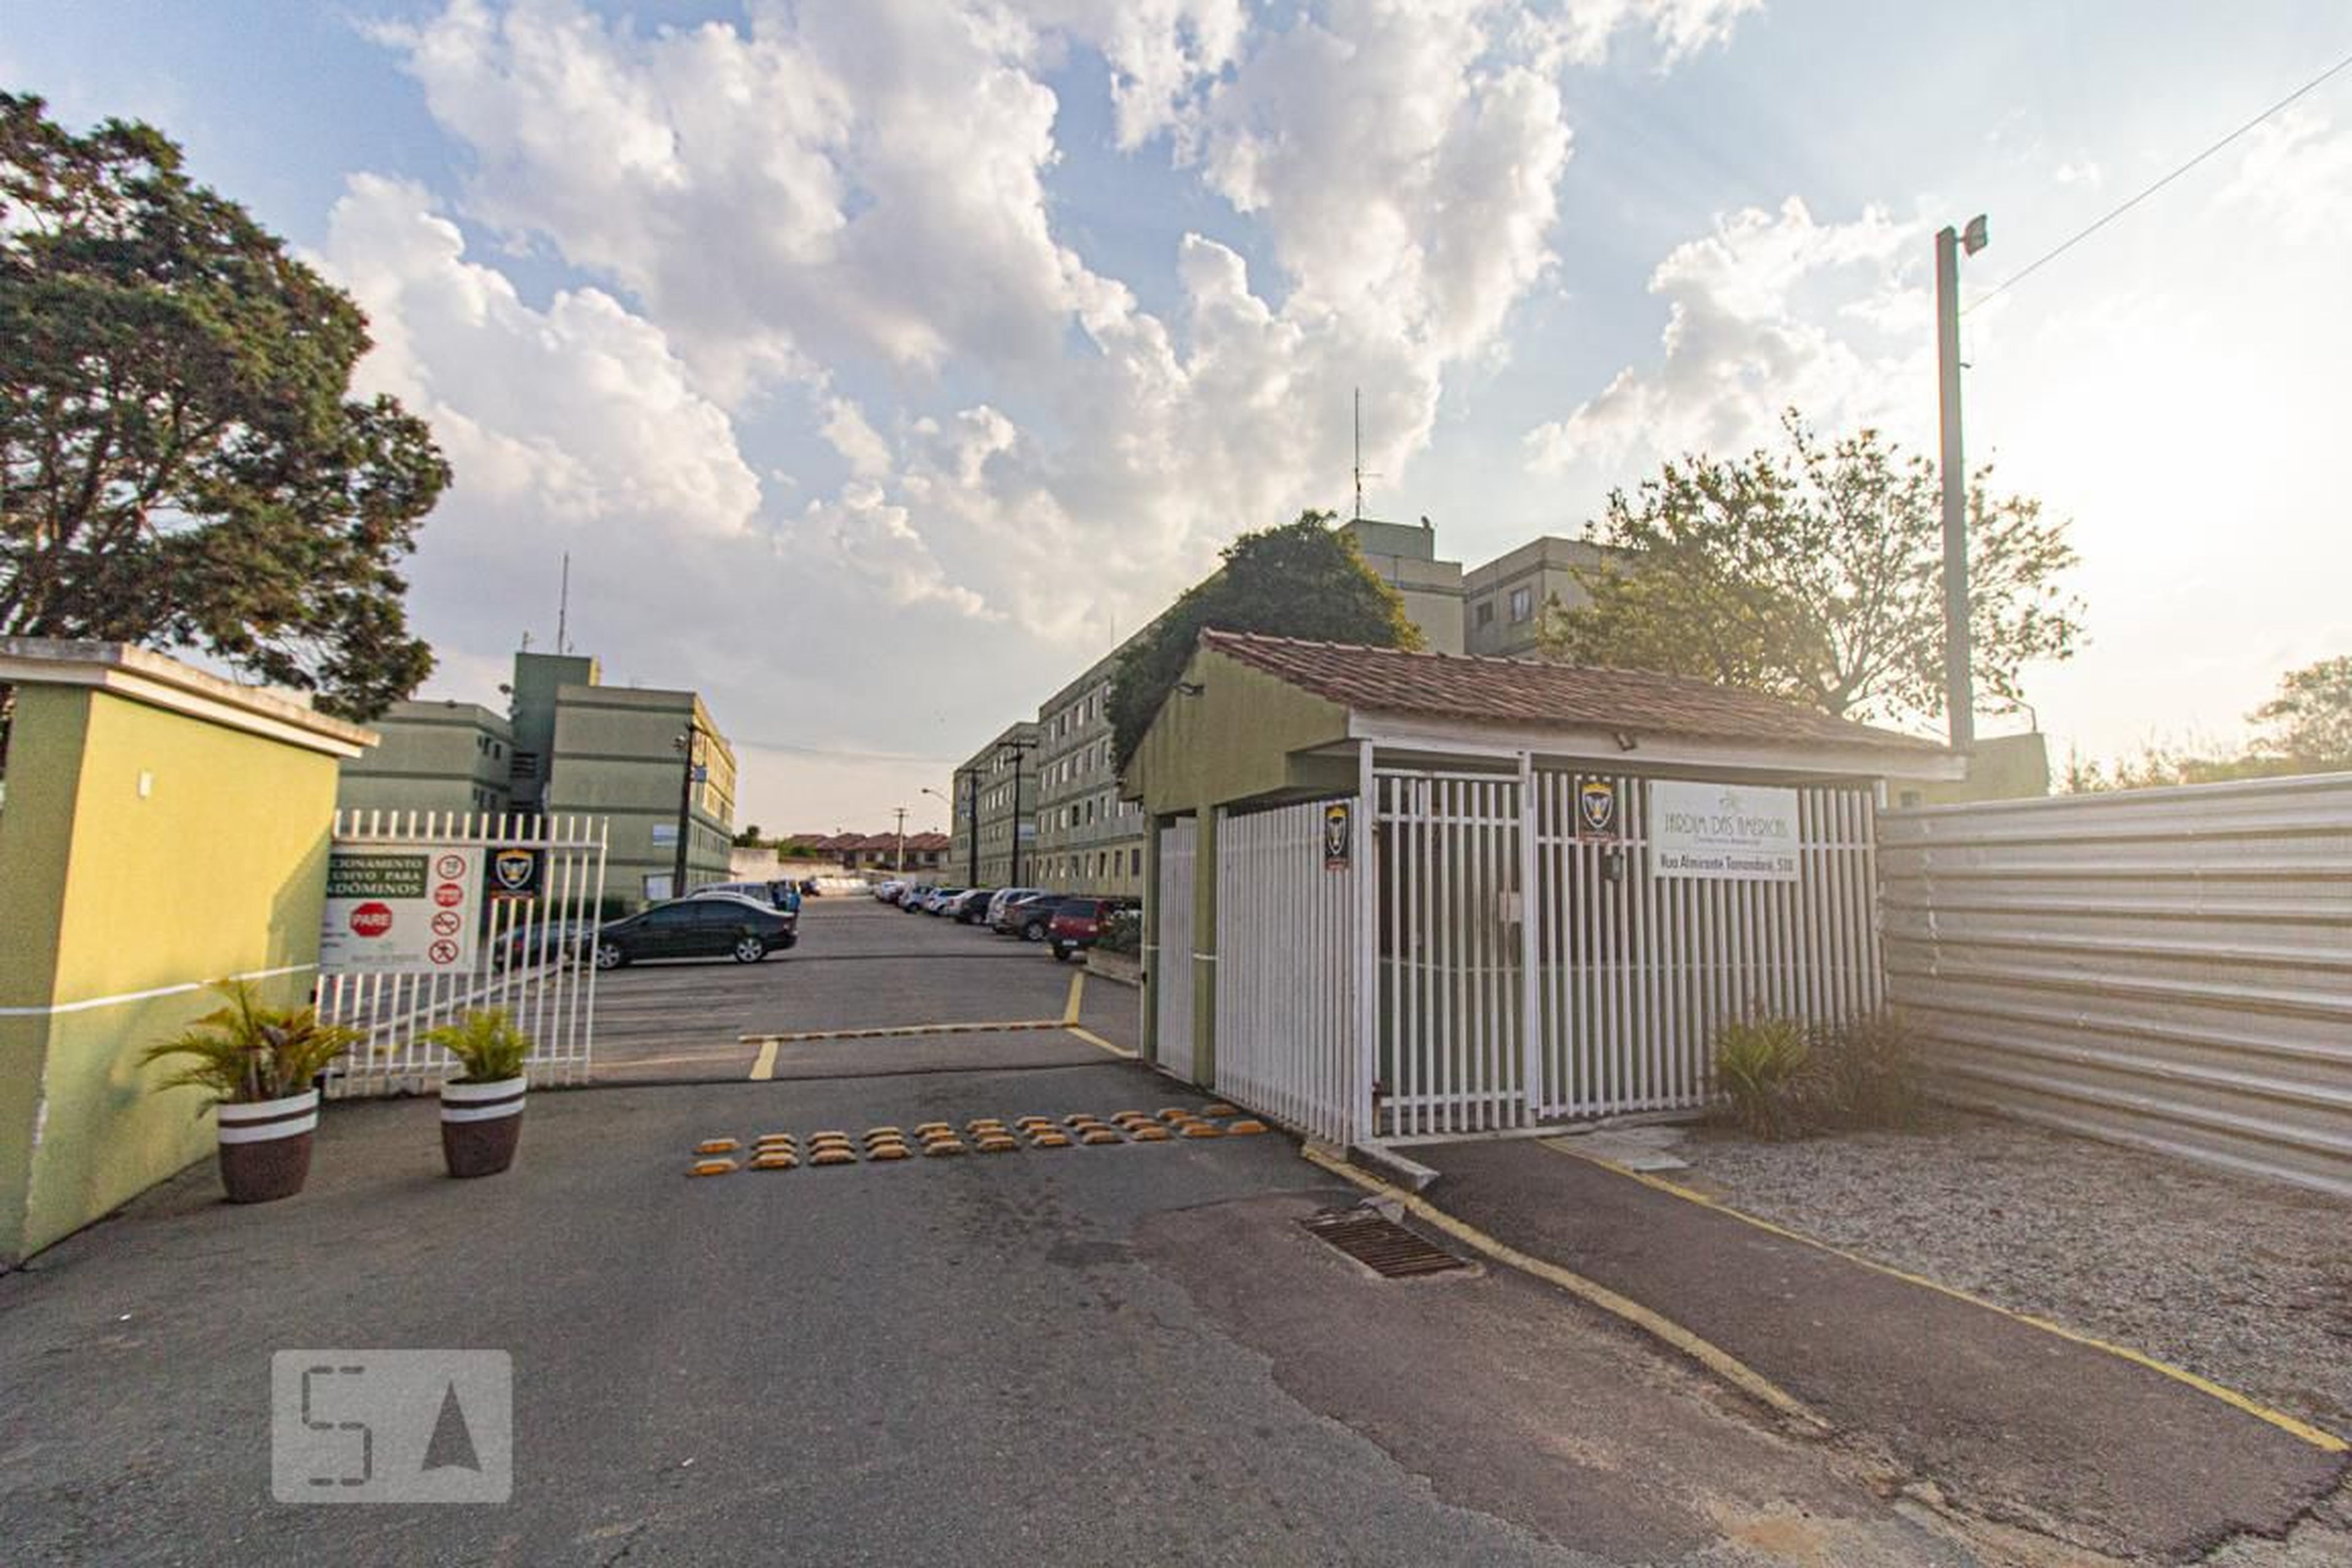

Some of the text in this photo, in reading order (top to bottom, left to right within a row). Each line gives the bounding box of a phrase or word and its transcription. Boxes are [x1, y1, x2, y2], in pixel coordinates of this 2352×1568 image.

[1711, 815, 1734, 835] DAS
[1660, 853, 1678, 869] Rua
[384, 871, 420, 881] PARA
[352, 913, 391, 926] PARE
